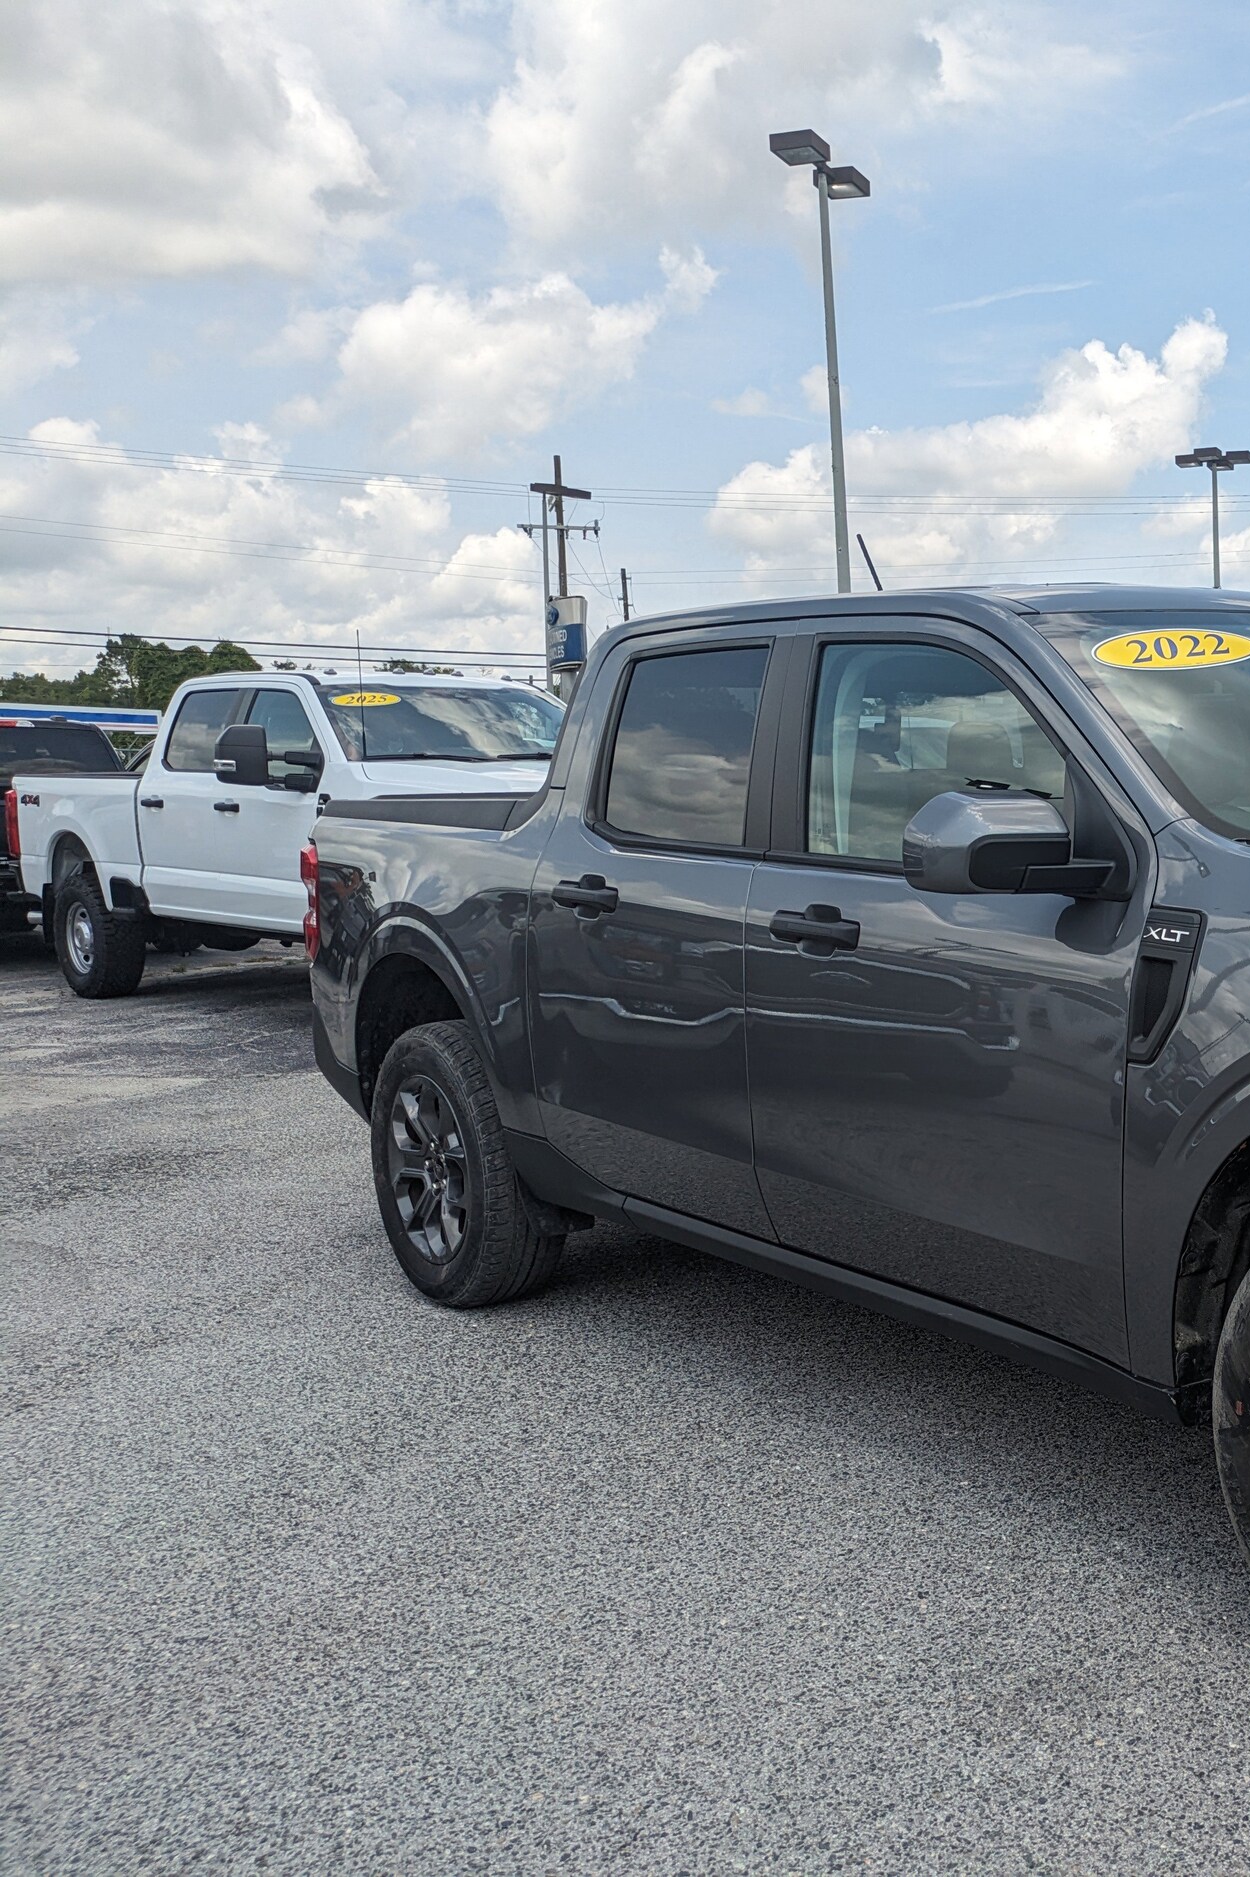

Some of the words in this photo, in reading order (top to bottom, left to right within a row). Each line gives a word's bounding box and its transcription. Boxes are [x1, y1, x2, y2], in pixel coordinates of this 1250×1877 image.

[1126, 634, 1230, 664] 2022
[344, 694, 388, 705] 2025
[1143, 926, 1190, 942] XLT
